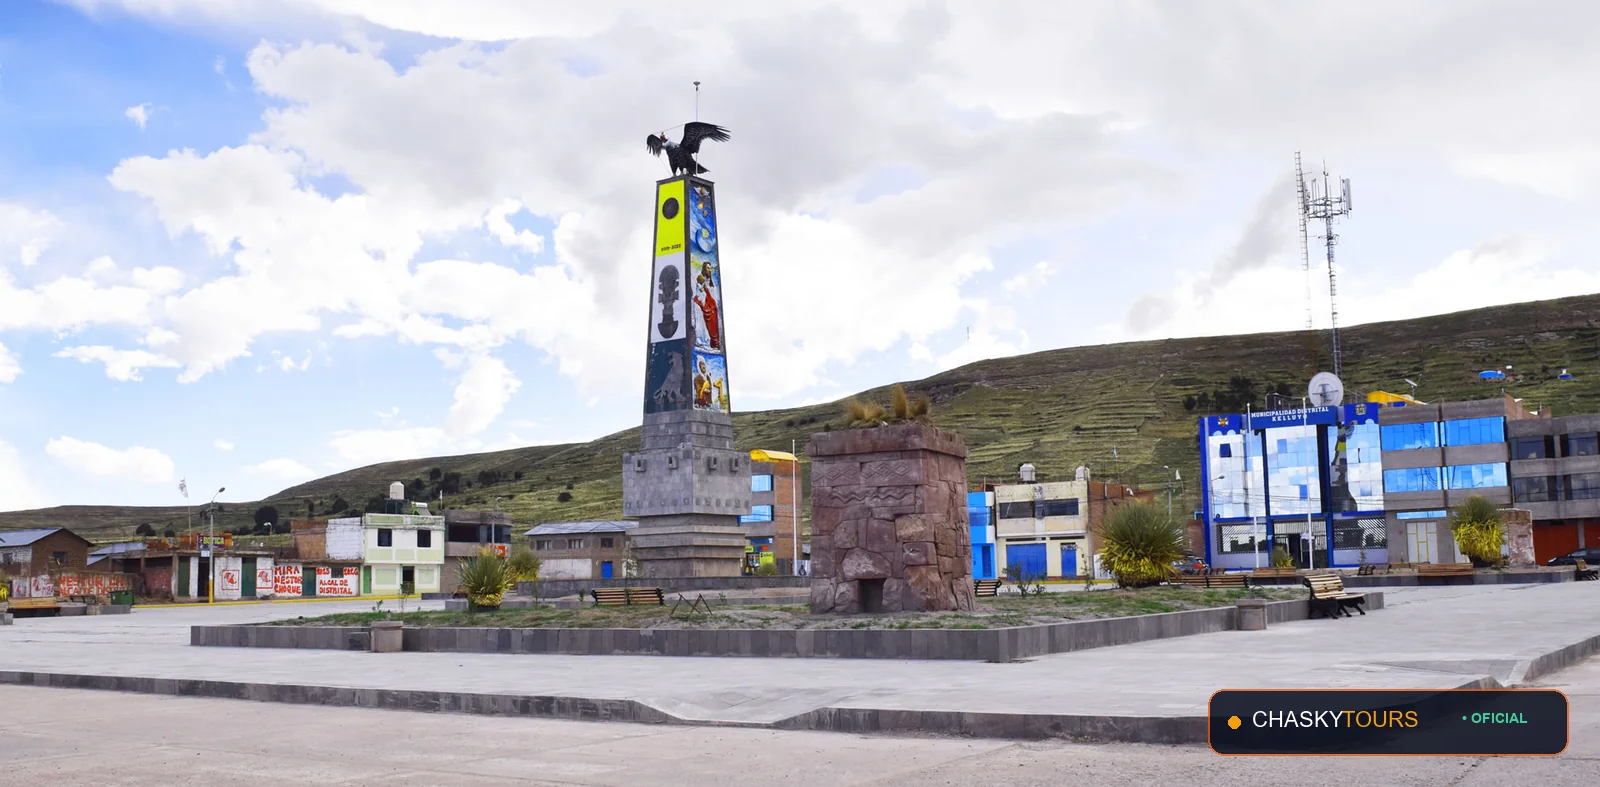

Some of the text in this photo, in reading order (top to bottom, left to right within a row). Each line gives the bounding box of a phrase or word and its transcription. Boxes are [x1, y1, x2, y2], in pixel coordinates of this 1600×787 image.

[1251, 406, 1329, 418] MUNICIPALIDAD DISTRITAL
[1272, 413, 1307, 422] KELLUYO
[274, 565, 300, 575] MIRA
[320, 587, 352, 595] DISTRITAL
